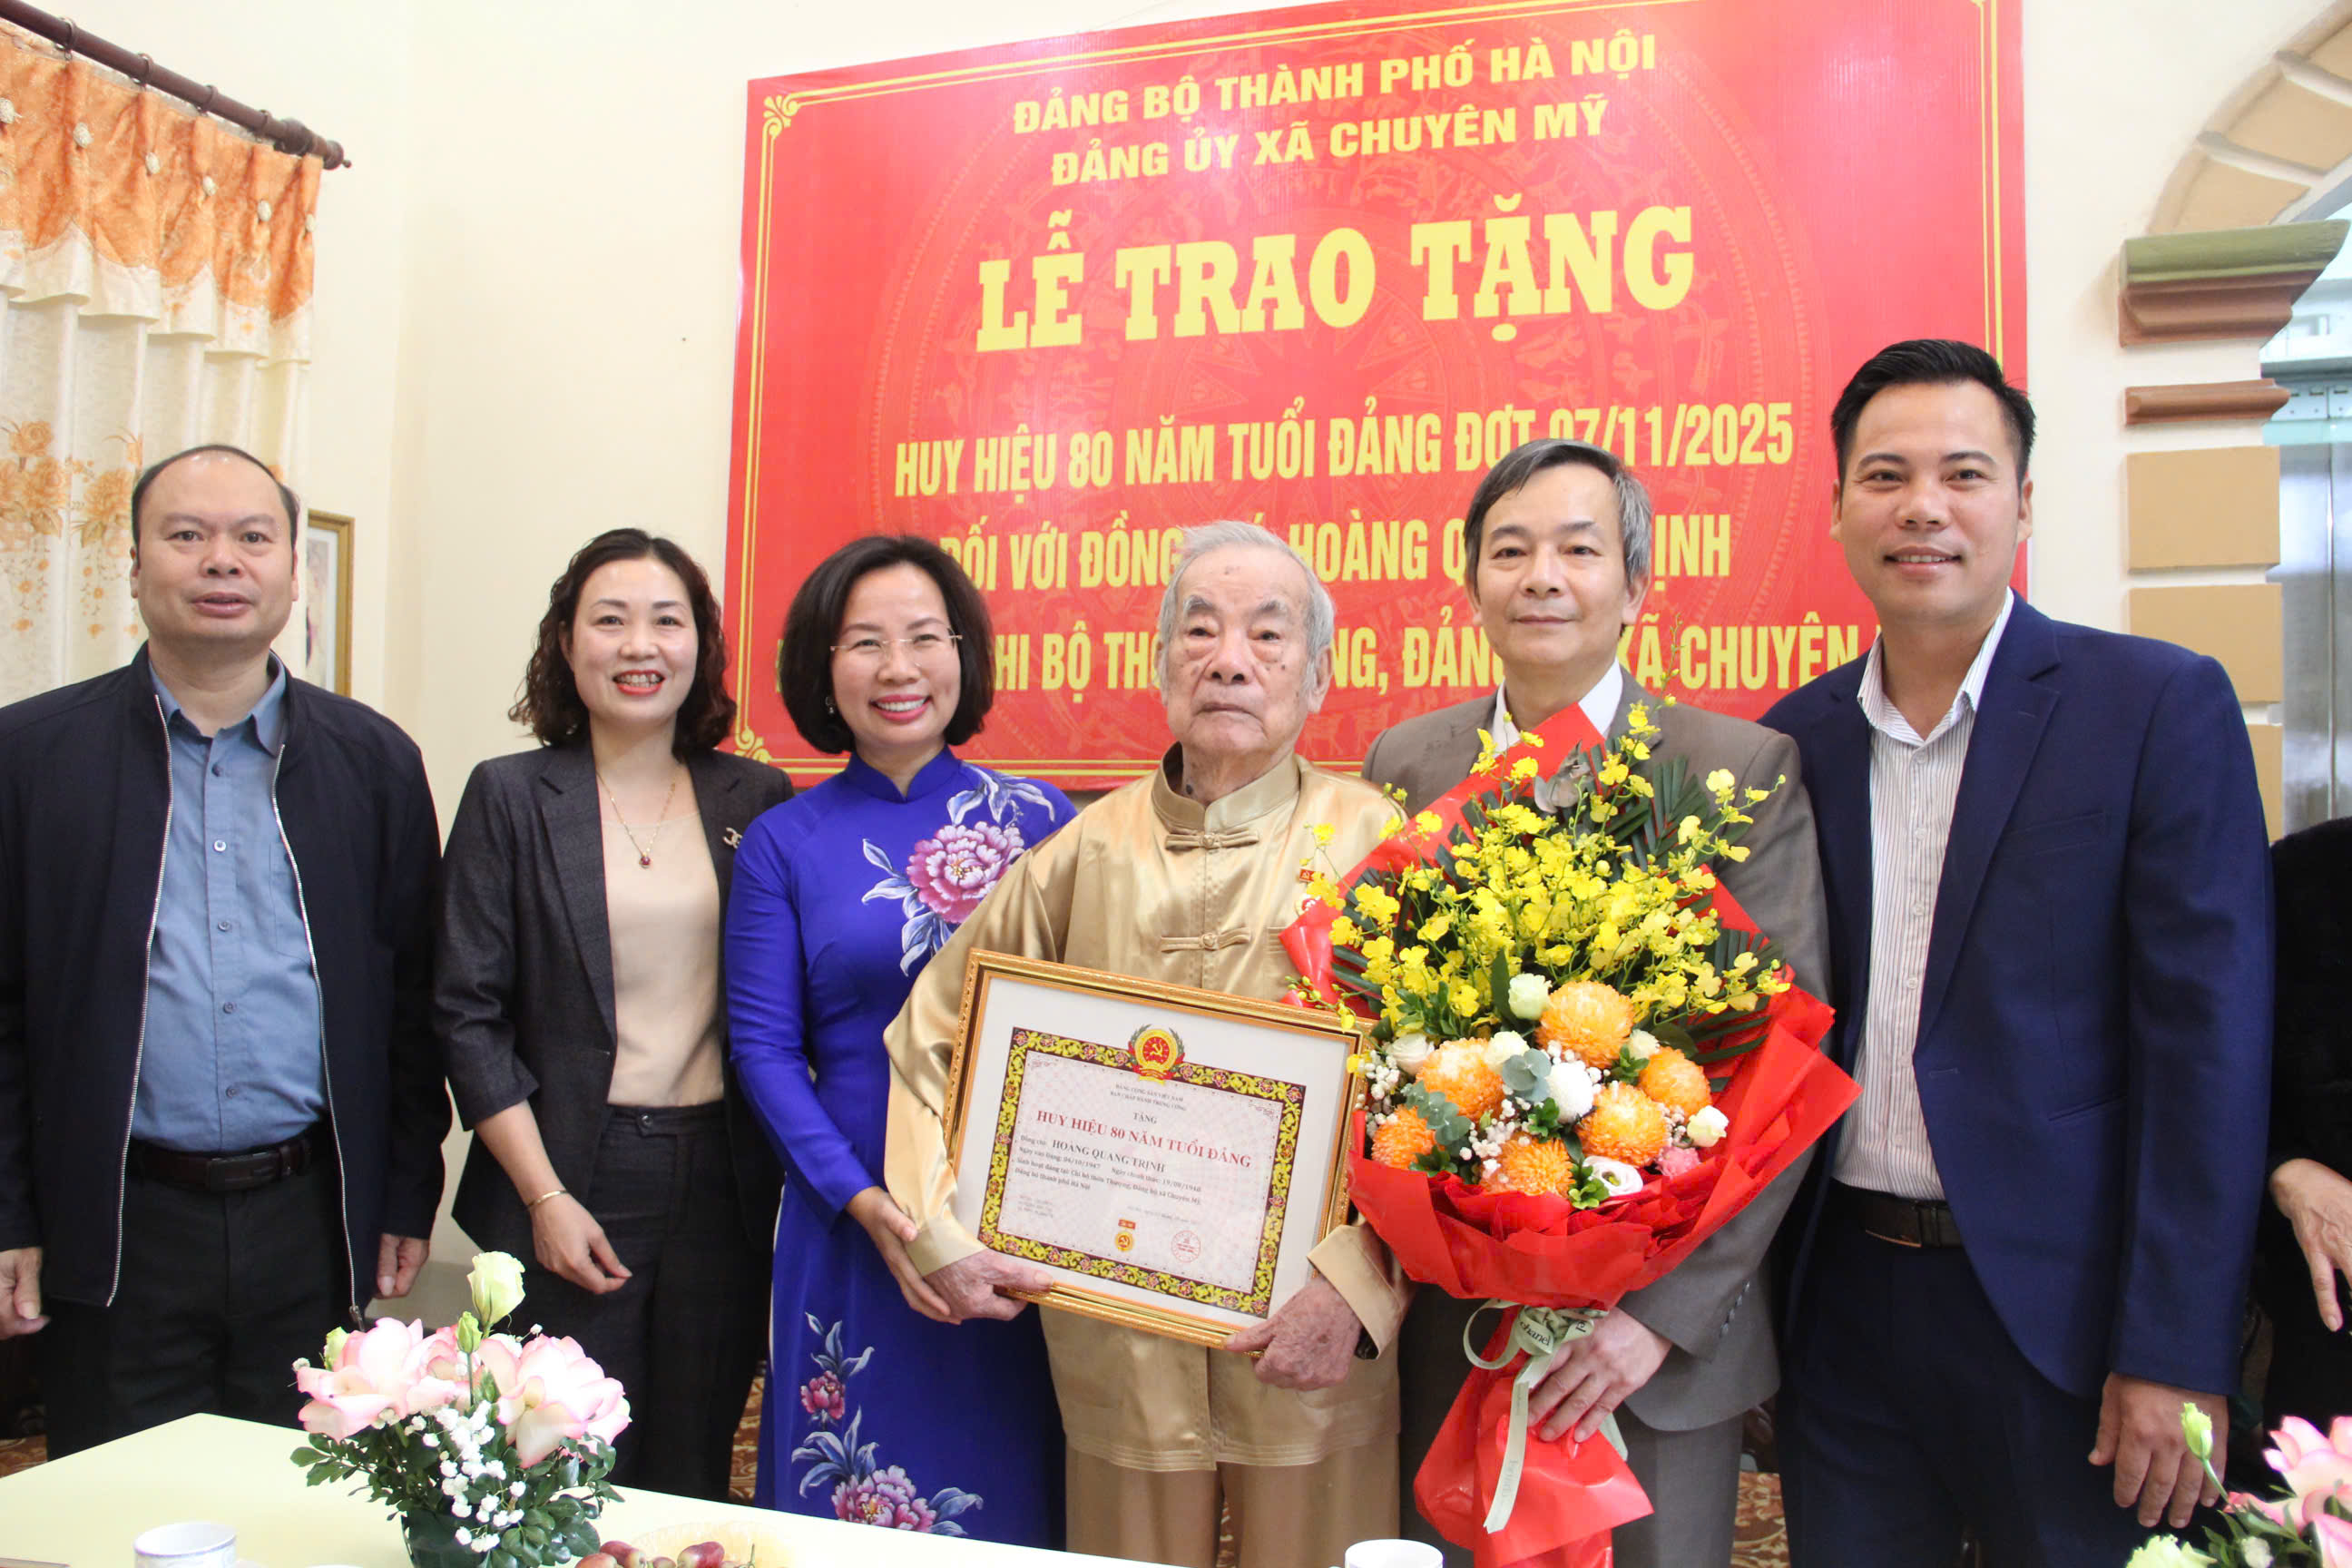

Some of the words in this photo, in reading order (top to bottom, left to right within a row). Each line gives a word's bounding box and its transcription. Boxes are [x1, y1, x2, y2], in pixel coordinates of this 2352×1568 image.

[1014, 87, 1129, 133] ĐẢNG
[1142, 74, 1200, 124] BỘ
[1215, 63, 1364, 111] THÀNH
[1379, 39, 1475, 94] PHỐ
[1489, 35, 1554, 84] HÀ
[1571, 28, 1656, 80] NỘI
[1051, 135, 1170, 186] ĐẢNG
[1184, 126, 1240, 172] ỦY
[1254, 121, 1315, 166] XÃ
[1329, 102, 1517, 158] CHUYÊN
[1534, 93, 1610, 141] MỸ
[975, 209, 1085, 353] LỄ
[1114, 227, 1377, 342] TRAO
[1410, 192, 1695, 342] TẶNG
[895, 438, 965, 497] HUY
[974, 424, 1058, 504] HIỆU
[1069, 431, 1114, 489] 80
[1124, 415, 1215, 485] NĂM
[1228, 396, 1316, 481] TUỔI
[1328, 396, 1442, 477] ĐẢNG
[1549, 402, 1794, 468] 07/11/2025
[1009, 520, 1068, 591] VỚI
[1078, 510, 1185, 588] ĐỒNG
[1288, 508, 1428, 583] HOÀNG
[1042, 620, 1092, 704] BỘ
[1402, 604, 1506, 688] ĐẢN
[1680, 611, 1859, 691] CHUYÊN
[1037, 1110, 1068, 1126] HUY
[1072, 1117, 1108, 1136] HIỆU
[1110, 1126, 1126, 1140] 80
[1128, 1130, 1163, 1149] NĂM
[1208, 1146, 1252, 1169] ĐẢNG
[1092, 1148, 1130, 1165] QUANG
[1132, 1156, 1166, 1173] TRỊNH
